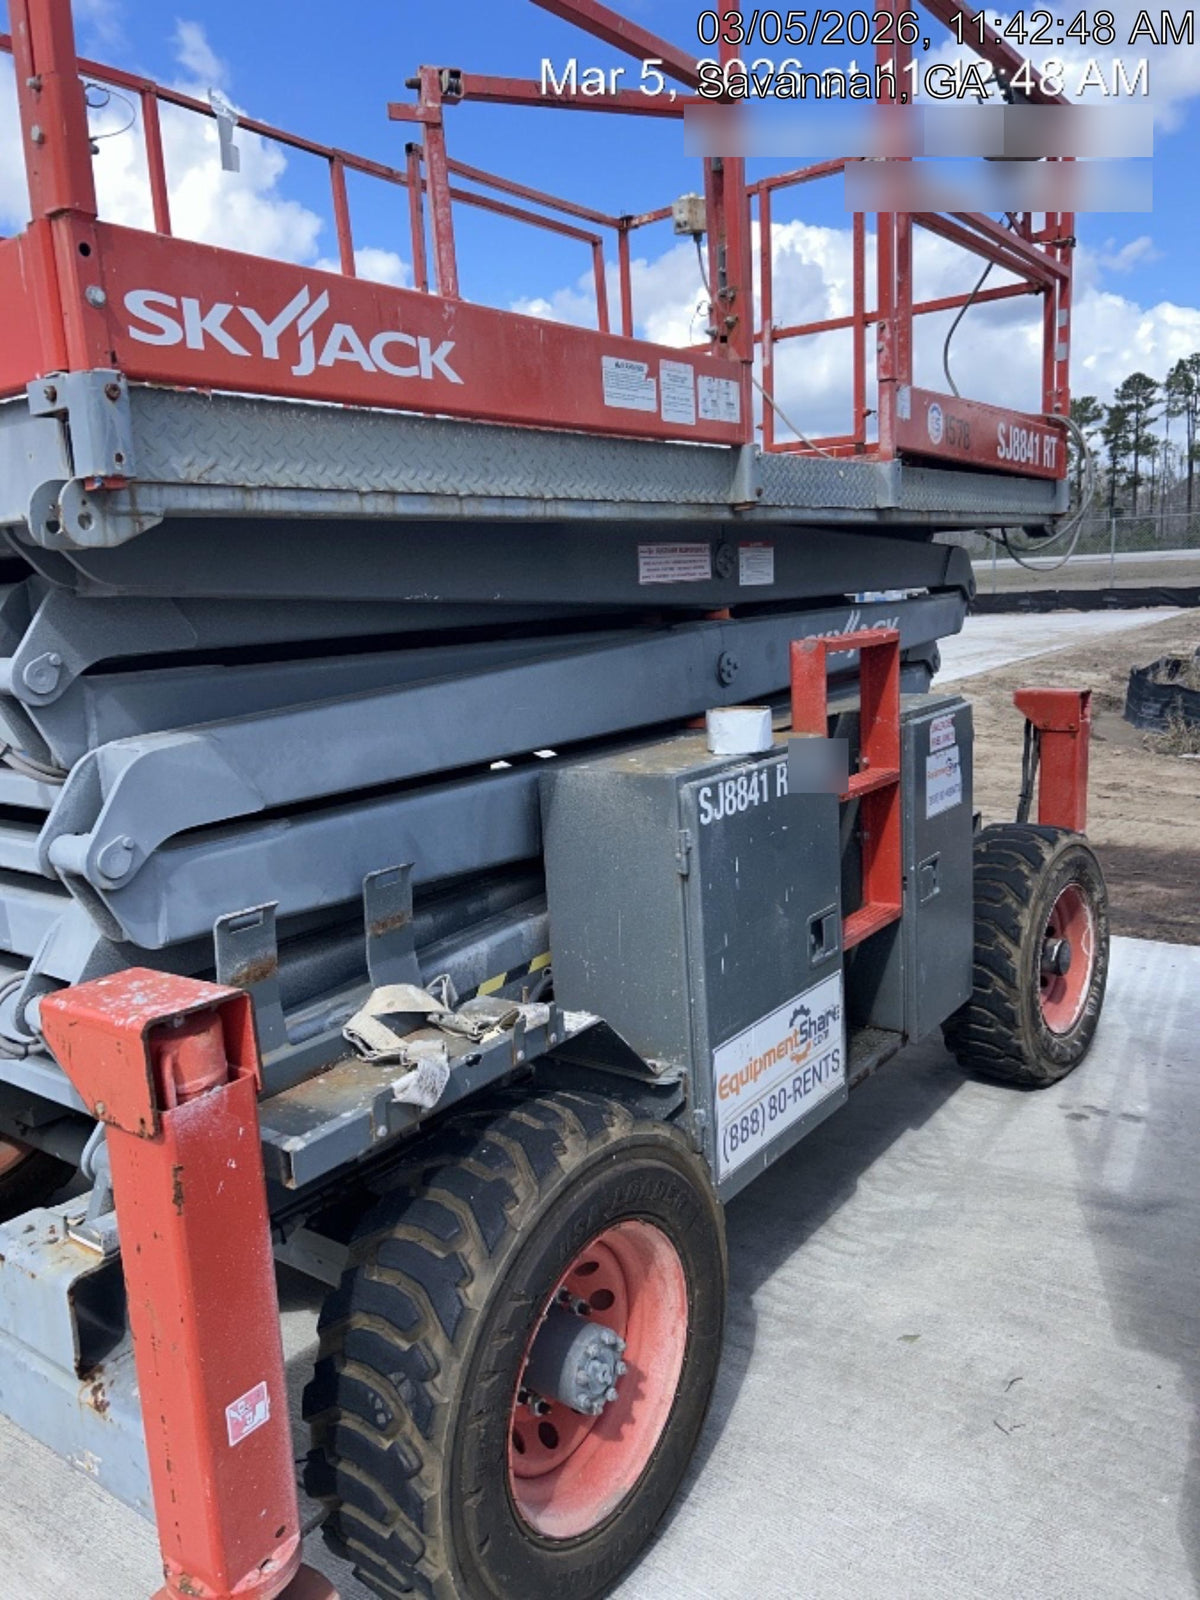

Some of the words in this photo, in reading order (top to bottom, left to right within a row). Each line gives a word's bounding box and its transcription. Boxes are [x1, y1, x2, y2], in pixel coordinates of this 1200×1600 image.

[123, 284, 464, 385] SKYJACK
[996, 422, 1040, 466] SJ8841
[1043, 434, 1058, 468] RT
[699, 767, 769, 825] SJ8841
[723, 1102, 766, 1163] (888)
[769, 1048, 841, 1123] 80-RENTS
